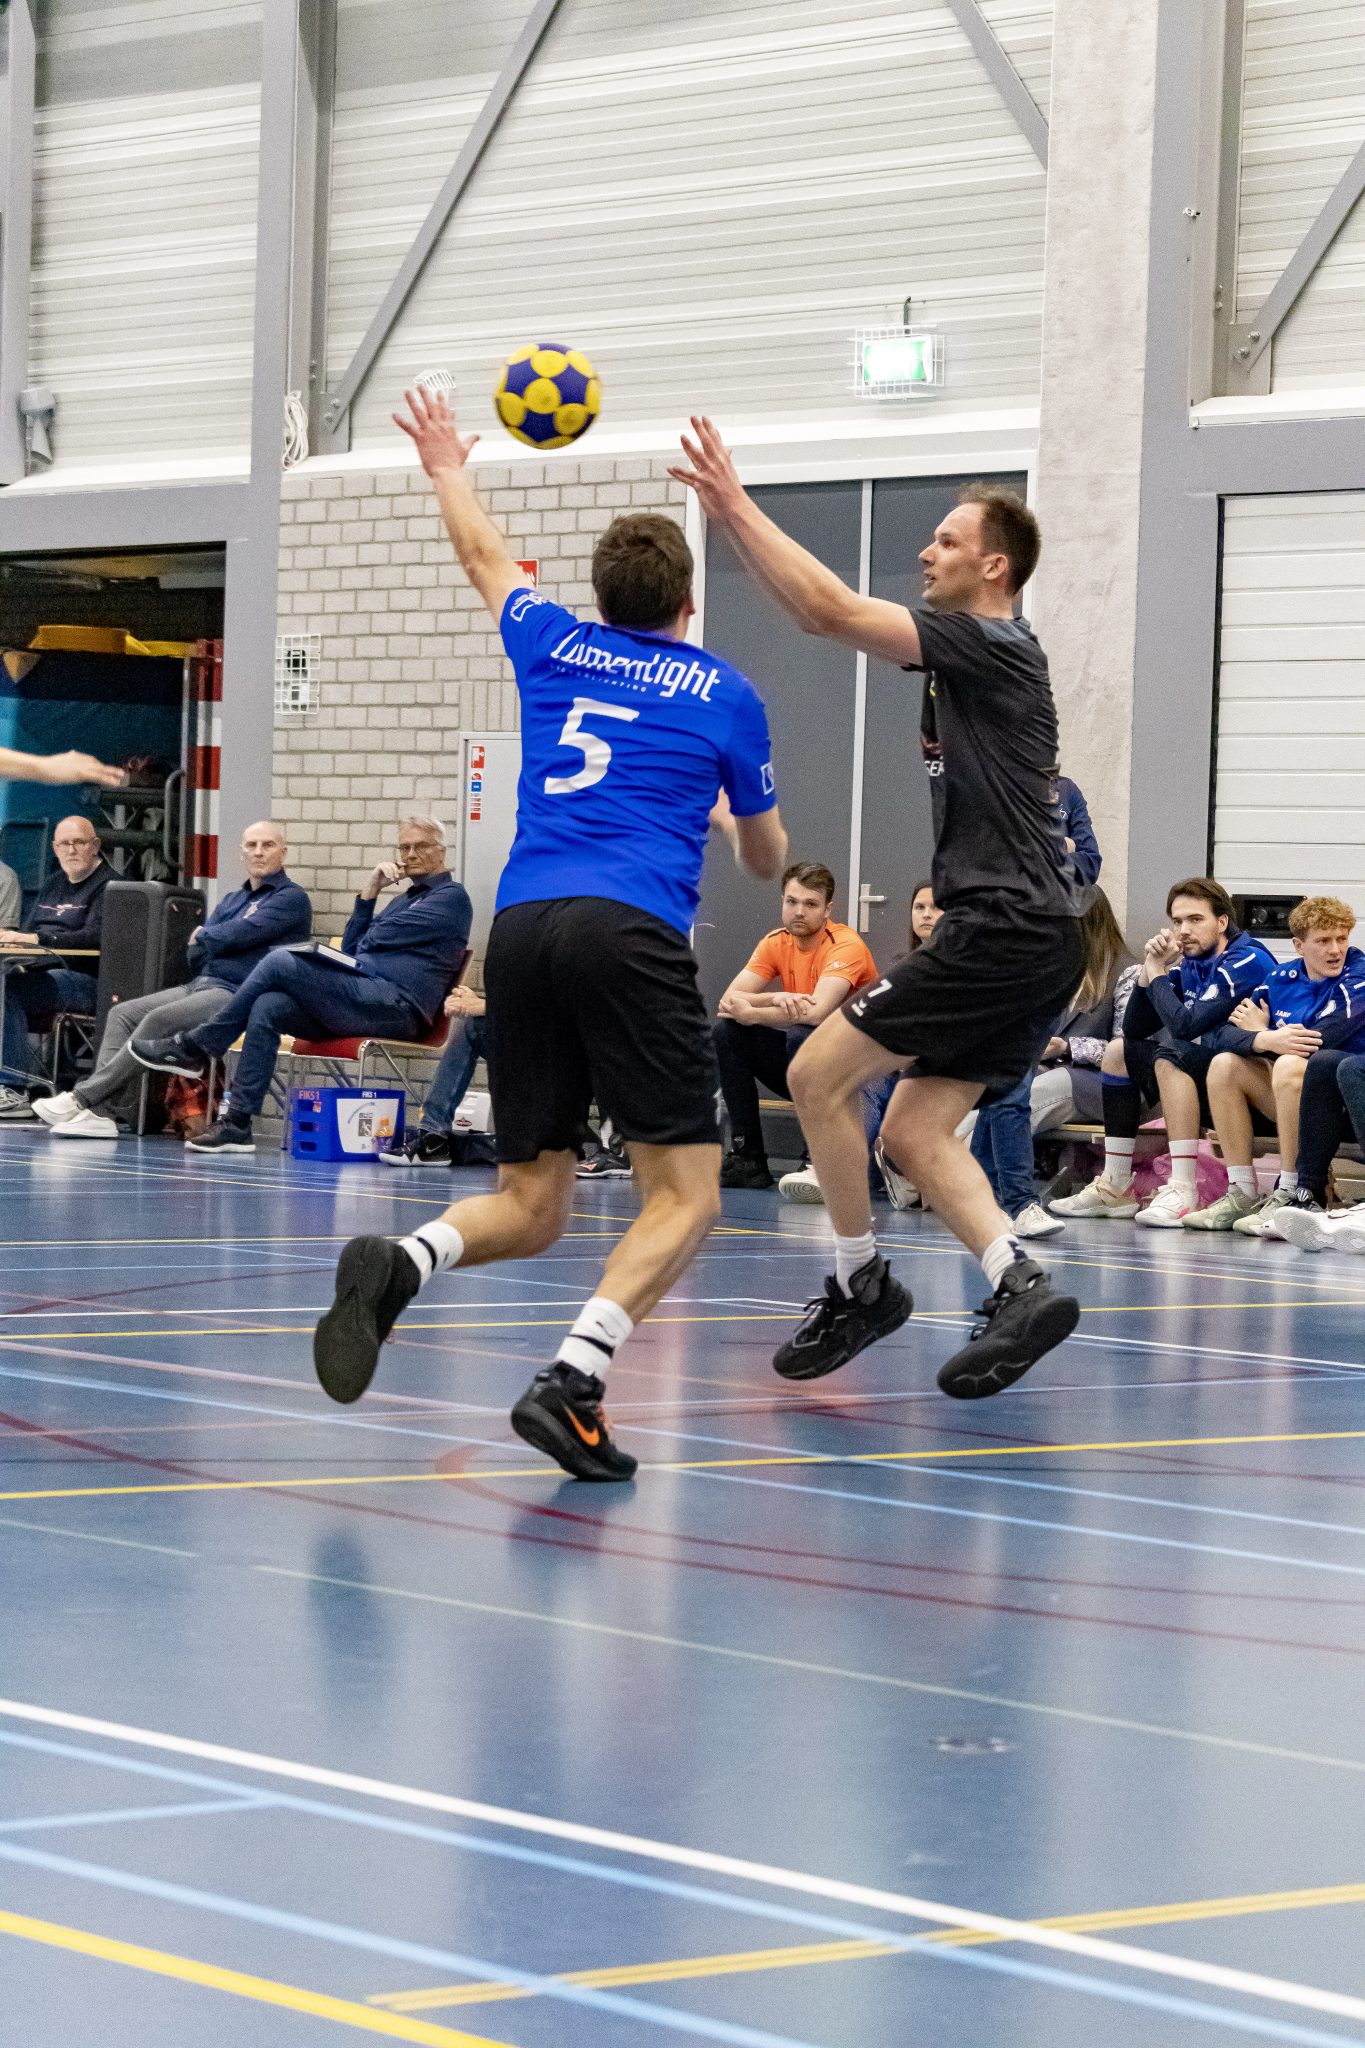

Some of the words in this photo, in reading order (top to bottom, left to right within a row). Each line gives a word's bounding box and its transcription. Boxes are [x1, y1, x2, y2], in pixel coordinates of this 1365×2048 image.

[551, 629, 720, 702] Lumenlight
[544, 697, 640, 795] 5
[867, 978, 893, 998] 7
